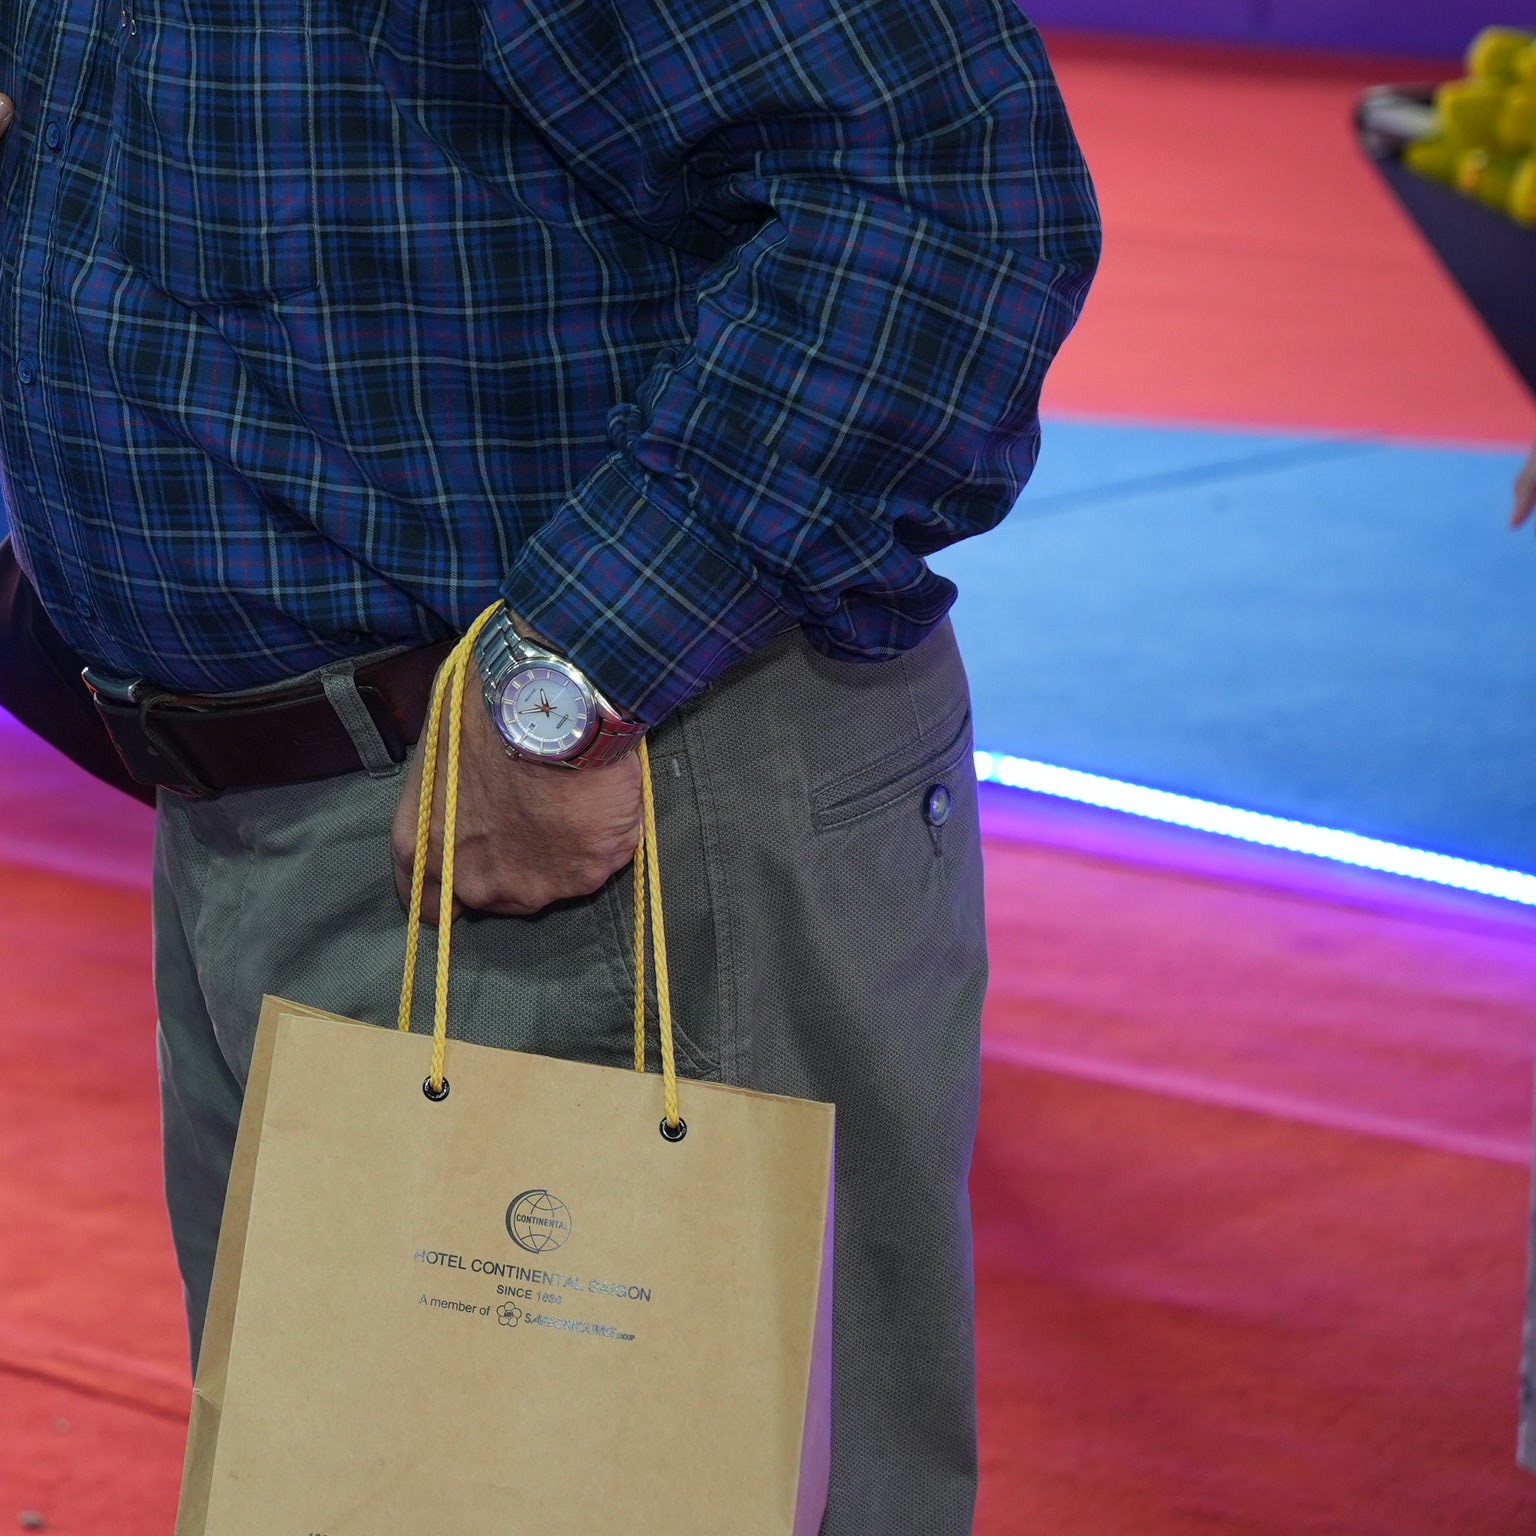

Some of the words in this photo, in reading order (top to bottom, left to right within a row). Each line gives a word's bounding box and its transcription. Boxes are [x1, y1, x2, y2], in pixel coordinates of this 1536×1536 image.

[516, 1213, 568, 1231] CONTINENTAL
[415, 1249, 467, 1270] HOTEL
[471, 1259, 584, 1292] CONTINENTAL
[588, 1279, 652, 1302] SAIGON
[496, 1284, 533, 1300] SINCE
[418, 1294, 428, 1306] A
[430, 1297, 477, 1314] member
[479, 1305, 492, 1317] of
